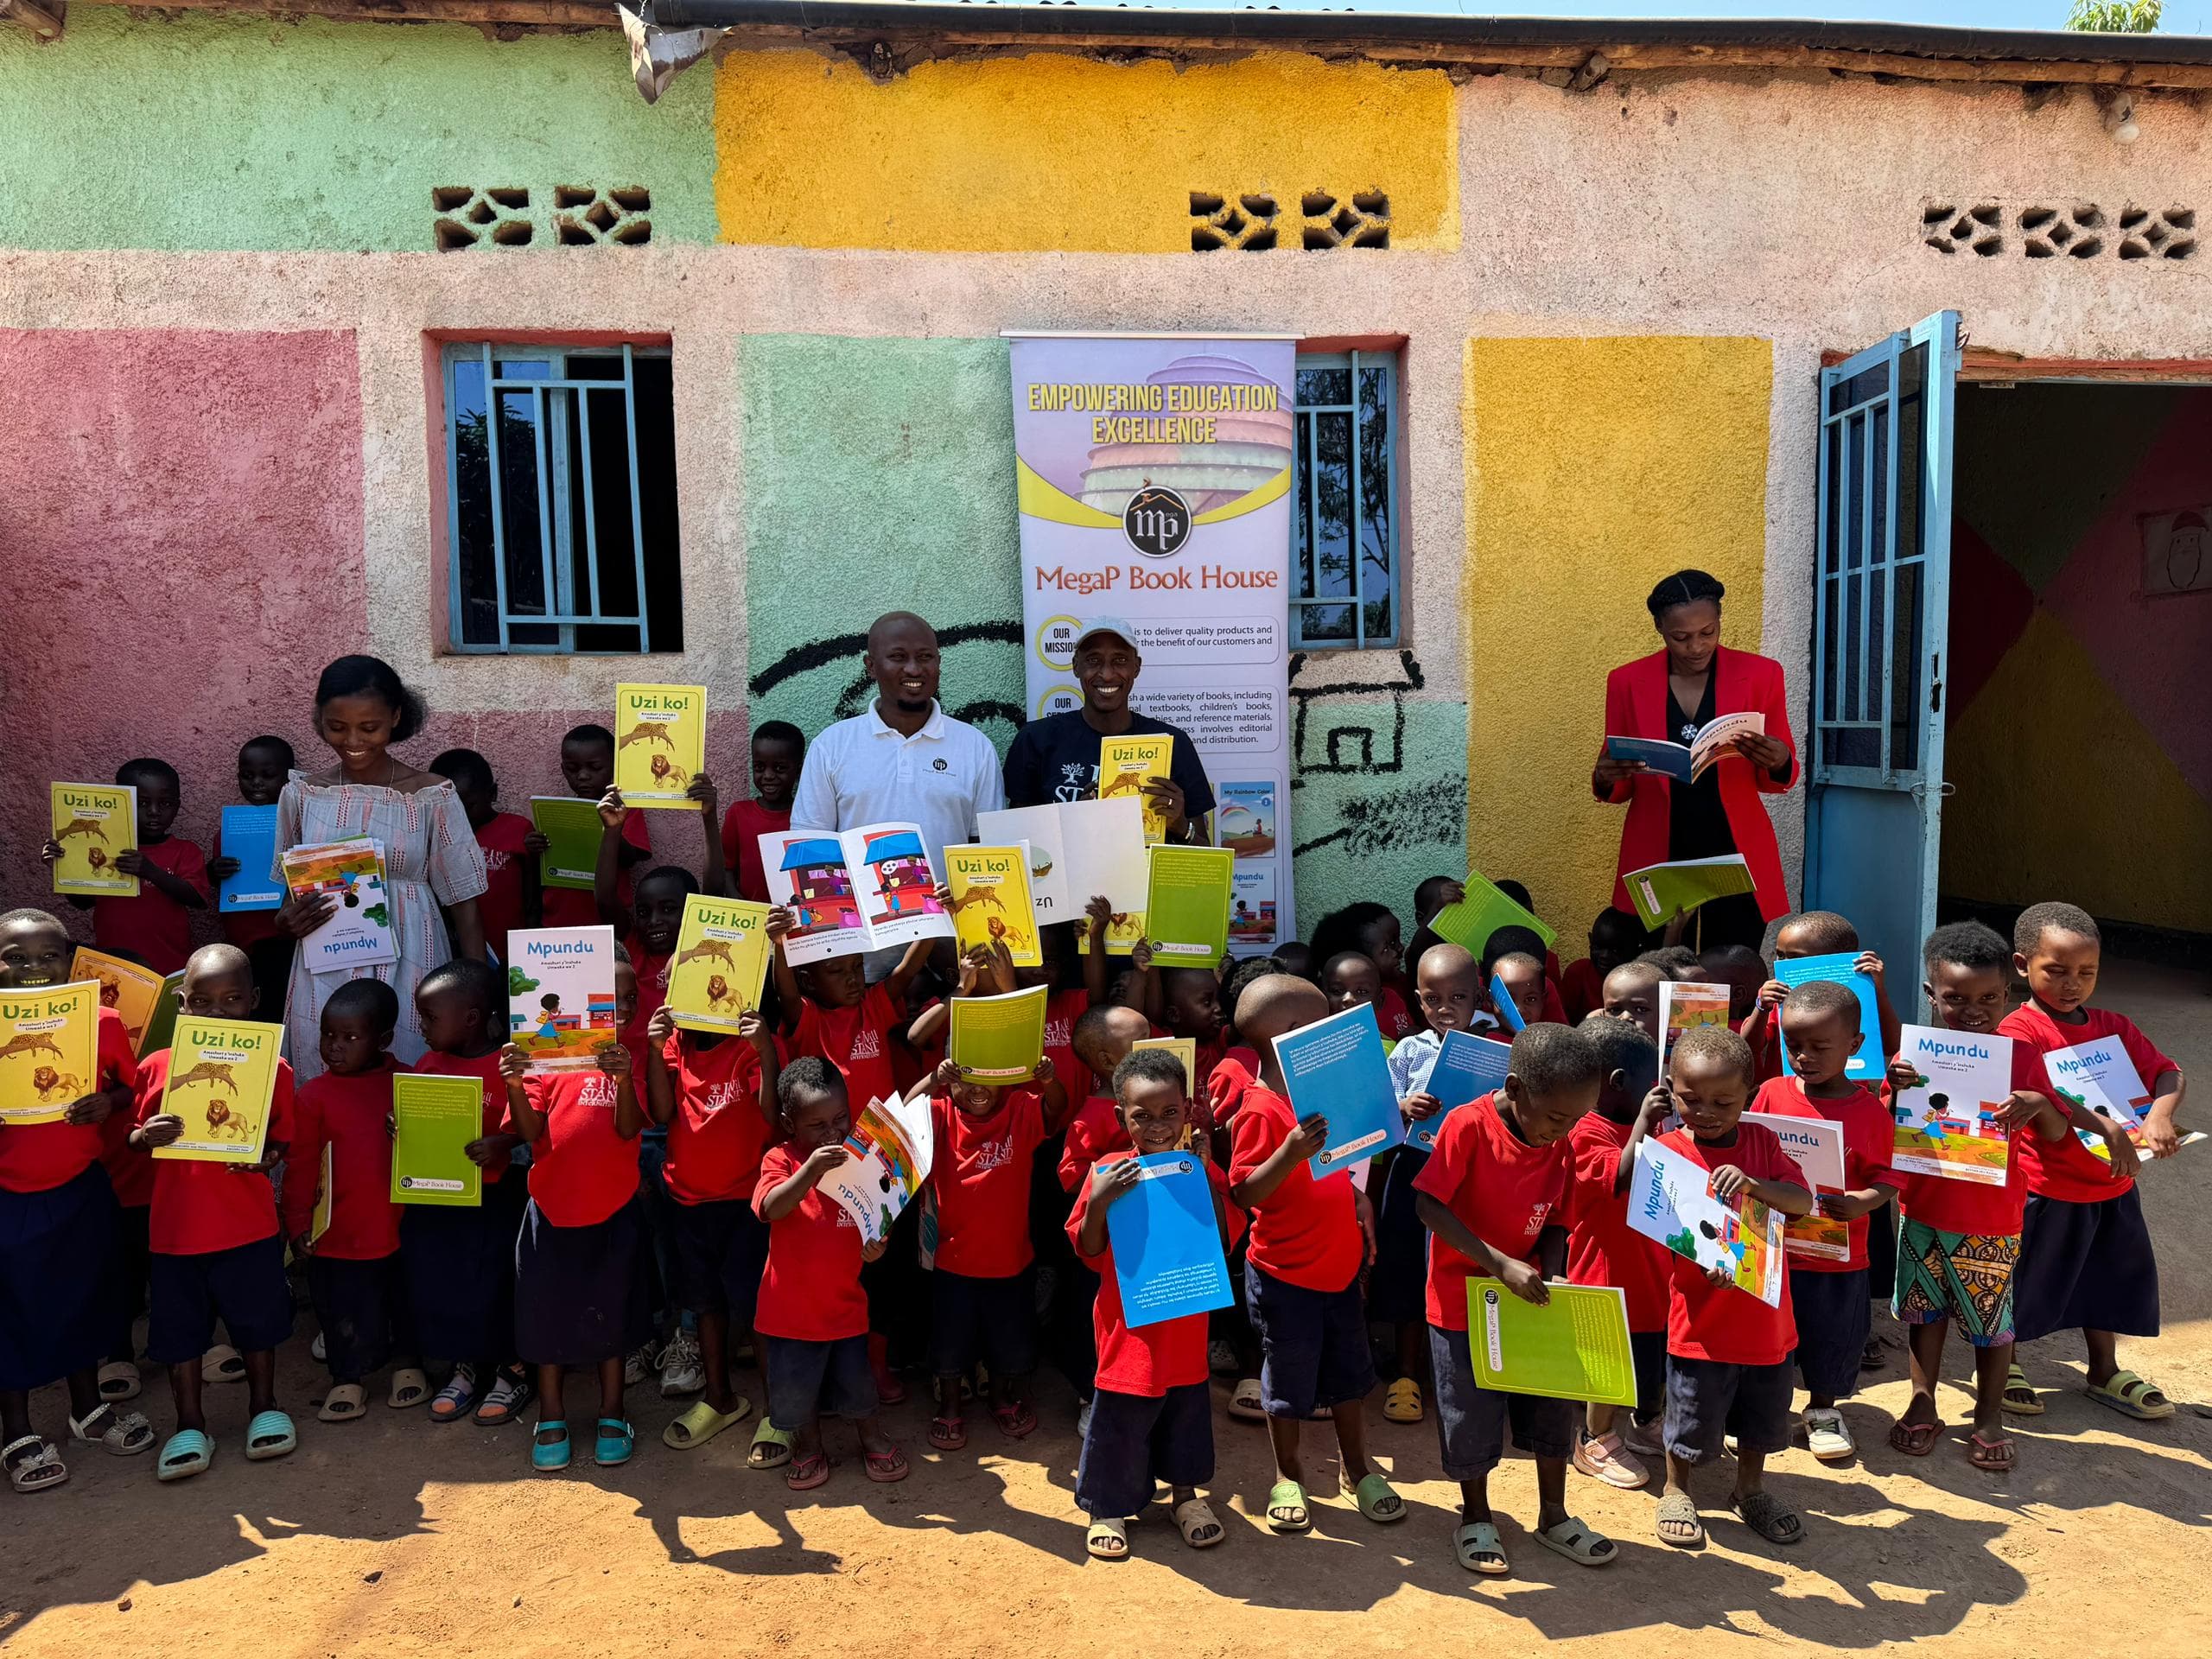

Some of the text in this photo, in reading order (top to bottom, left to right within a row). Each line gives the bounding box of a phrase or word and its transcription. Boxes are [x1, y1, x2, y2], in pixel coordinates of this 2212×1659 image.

[1028, 384, 1279, 412] EMPOWERING EDUCATION
[1092, 416, 1217, 444] EXCELLENCE
[1036, 565, 1278, 594] MegaP Book House
[1053, 628, 1071, 639] OUR
[1185, 626, 1214, 636] quality
[1217, 626, 1254, 636] products
[1156, 638, 1185, 646] benefit
[1212, 638, 1255, 646] customers
[631, 696, 689, 710] Uzi ko!
[1055, 697, 1071, 708] OUR
[1146, 692, 1166, 701] wide
[1166, 692, 1195, 702] variety
[1206, 691, 1233, 701] books,
[1234, 691, 1272, 701] including
[1149, 703, 1192, 713] textbooks,
[1199, 702, 1237, 711] children's
[1246, 702, 1272, 711] books,
[1194, 714, 1231, 722] reference
[1234, 713, 1272, 721] materials.
[1200, 724, 1233, 733] involves
[1239, 723, 1272, 732] editorial
[1700, 720, 1747, 745] Mpundu
[1192, 734, 1258, 744] and distribution.
[1113, 747, 1159, 760] Uzi ko!
[64, 793, 118, 809] Uzi ko!
[957, 859, 1010, 873] Uzi ko!
[1233, 872, 1264, 882] Mpundu
[698, 909, 757, 930] Uzi ko!
[323, 936, 378, 955] Mpundu
[527, 940, 594, 958] Mpundu
[3, 996, 78, 1020] Uzi ko!
[192, 1030, 262, 1050] Uzi ko!
[1918, 1038, 1989, 1059] Mpundu
[2056, 1051, 2112, 1074] Mpundu
[1643, 1160, 1664, 1221] Mpundu
[838, 1184, 874, 1236] Mpundu
